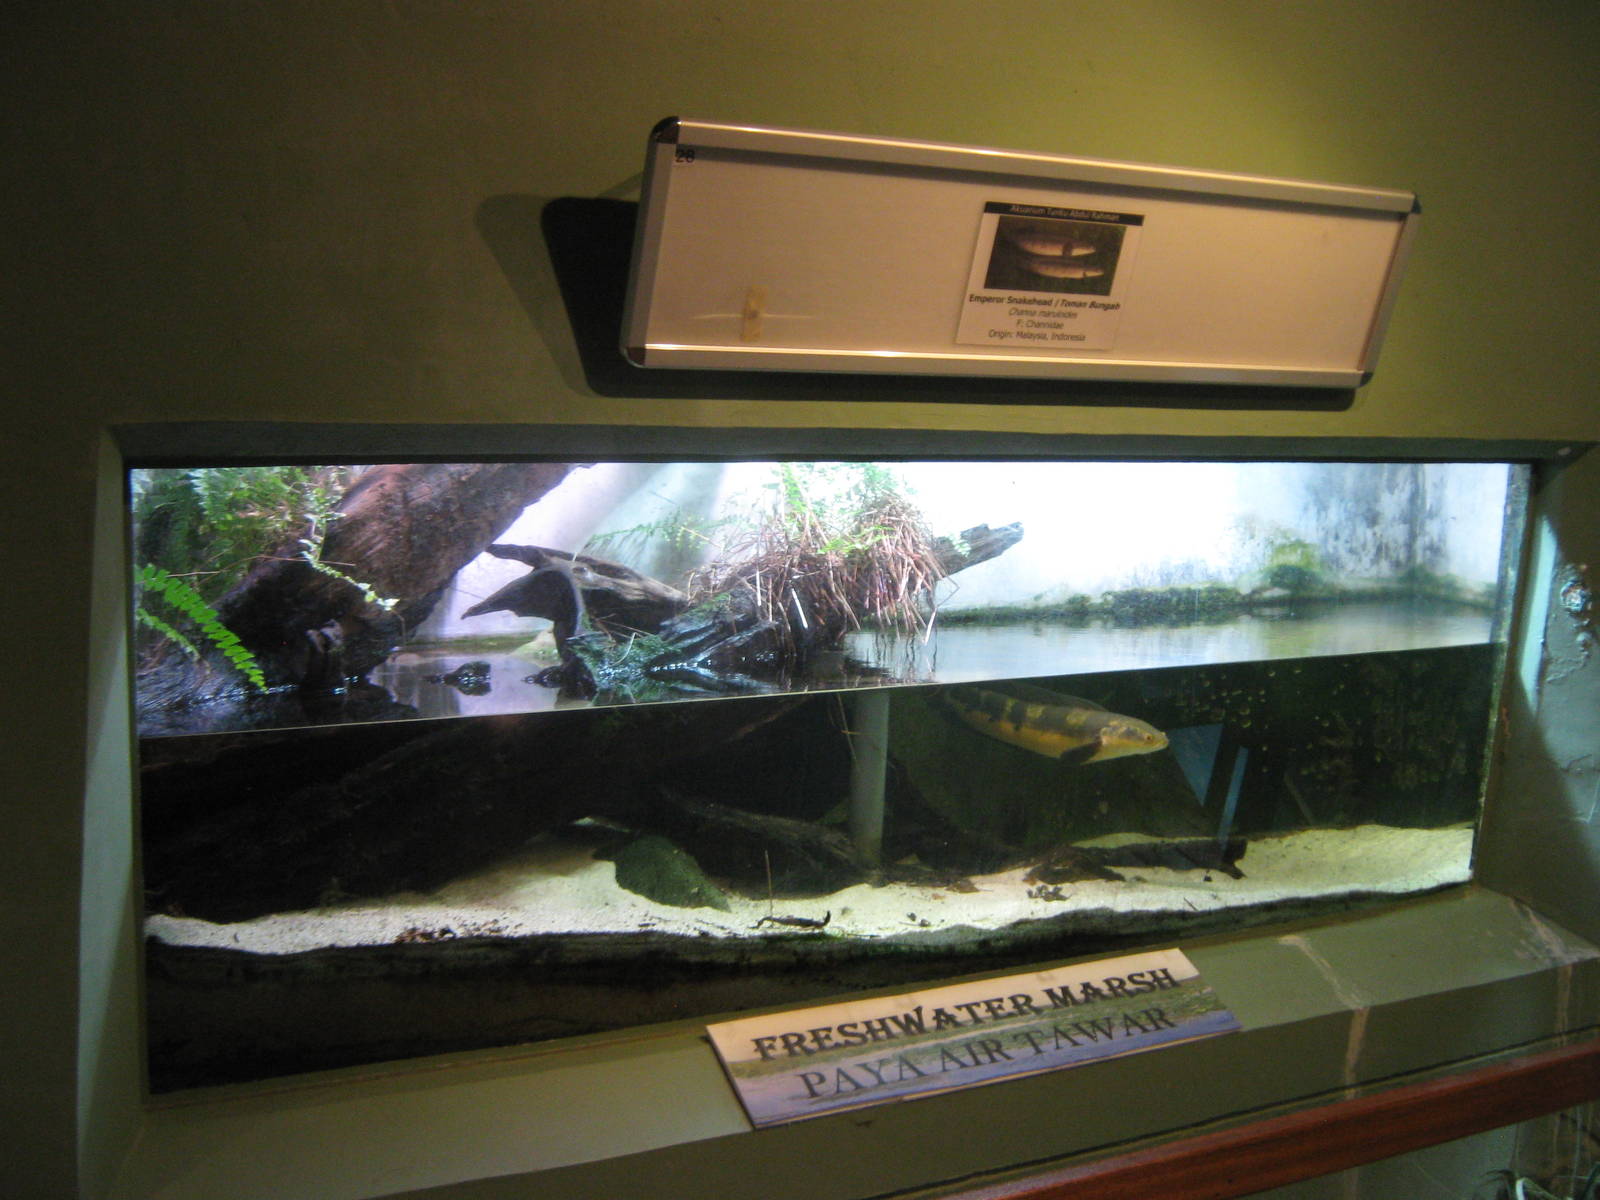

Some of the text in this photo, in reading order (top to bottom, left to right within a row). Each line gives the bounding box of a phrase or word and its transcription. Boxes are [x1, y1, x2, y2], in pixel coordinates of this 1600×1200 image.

[969, 294, 1004, 304] Emperor
[1007, 296, 1053, 306] Snakehead
[1051, 333, 1086, 341] Indonesia
[752, 967, 1180, 1063] FRESHWATER MARSH
[798, 1006, 1177, 1101] PAYA AIR TAWAR
